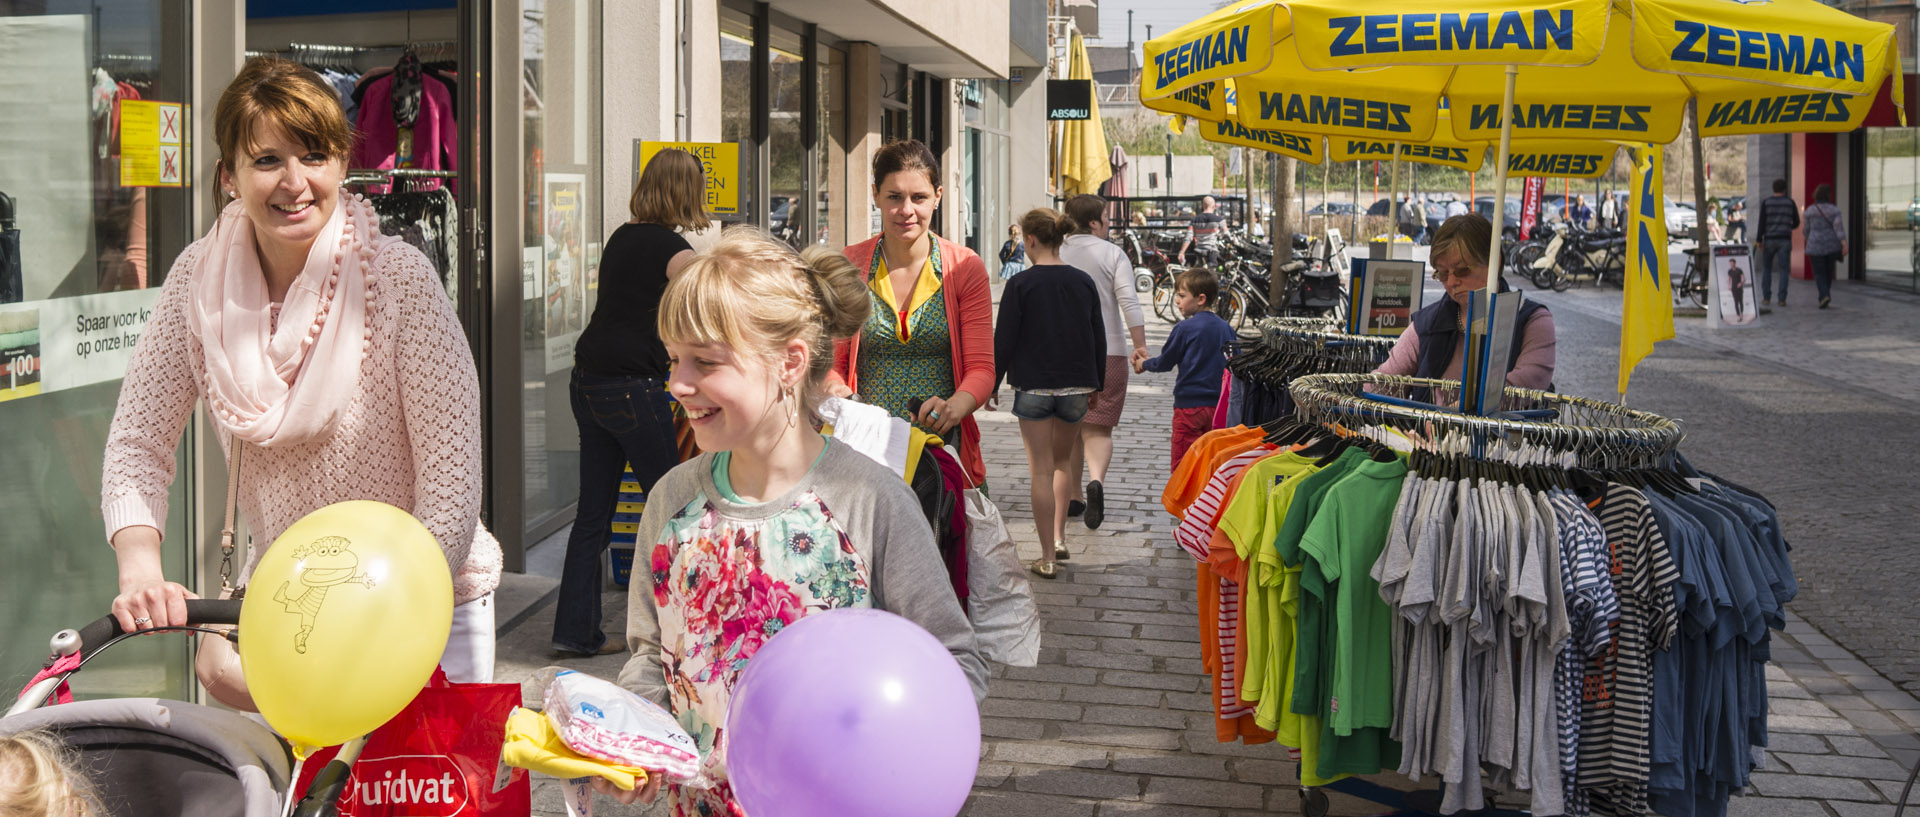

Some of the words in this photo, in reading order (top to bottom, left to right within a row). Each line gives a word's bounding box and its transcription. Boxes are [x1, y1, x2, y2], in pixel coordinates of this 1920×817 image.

[1329, 9, 1573, 57] ZEEMAN
[1671, 20, 1864, 82] ZEEMAN
[1154, 25, 1250, 90] ZEEMAN
[1051, 108, 1088, 118] ABSOLU
[76, 314, 110, 336] Spaar
[113, 312, 137, 327] voor
[77, 341, 91, 359] op
[94, 336, 120, 352] onze
[6, 354, 34, 391] 100
